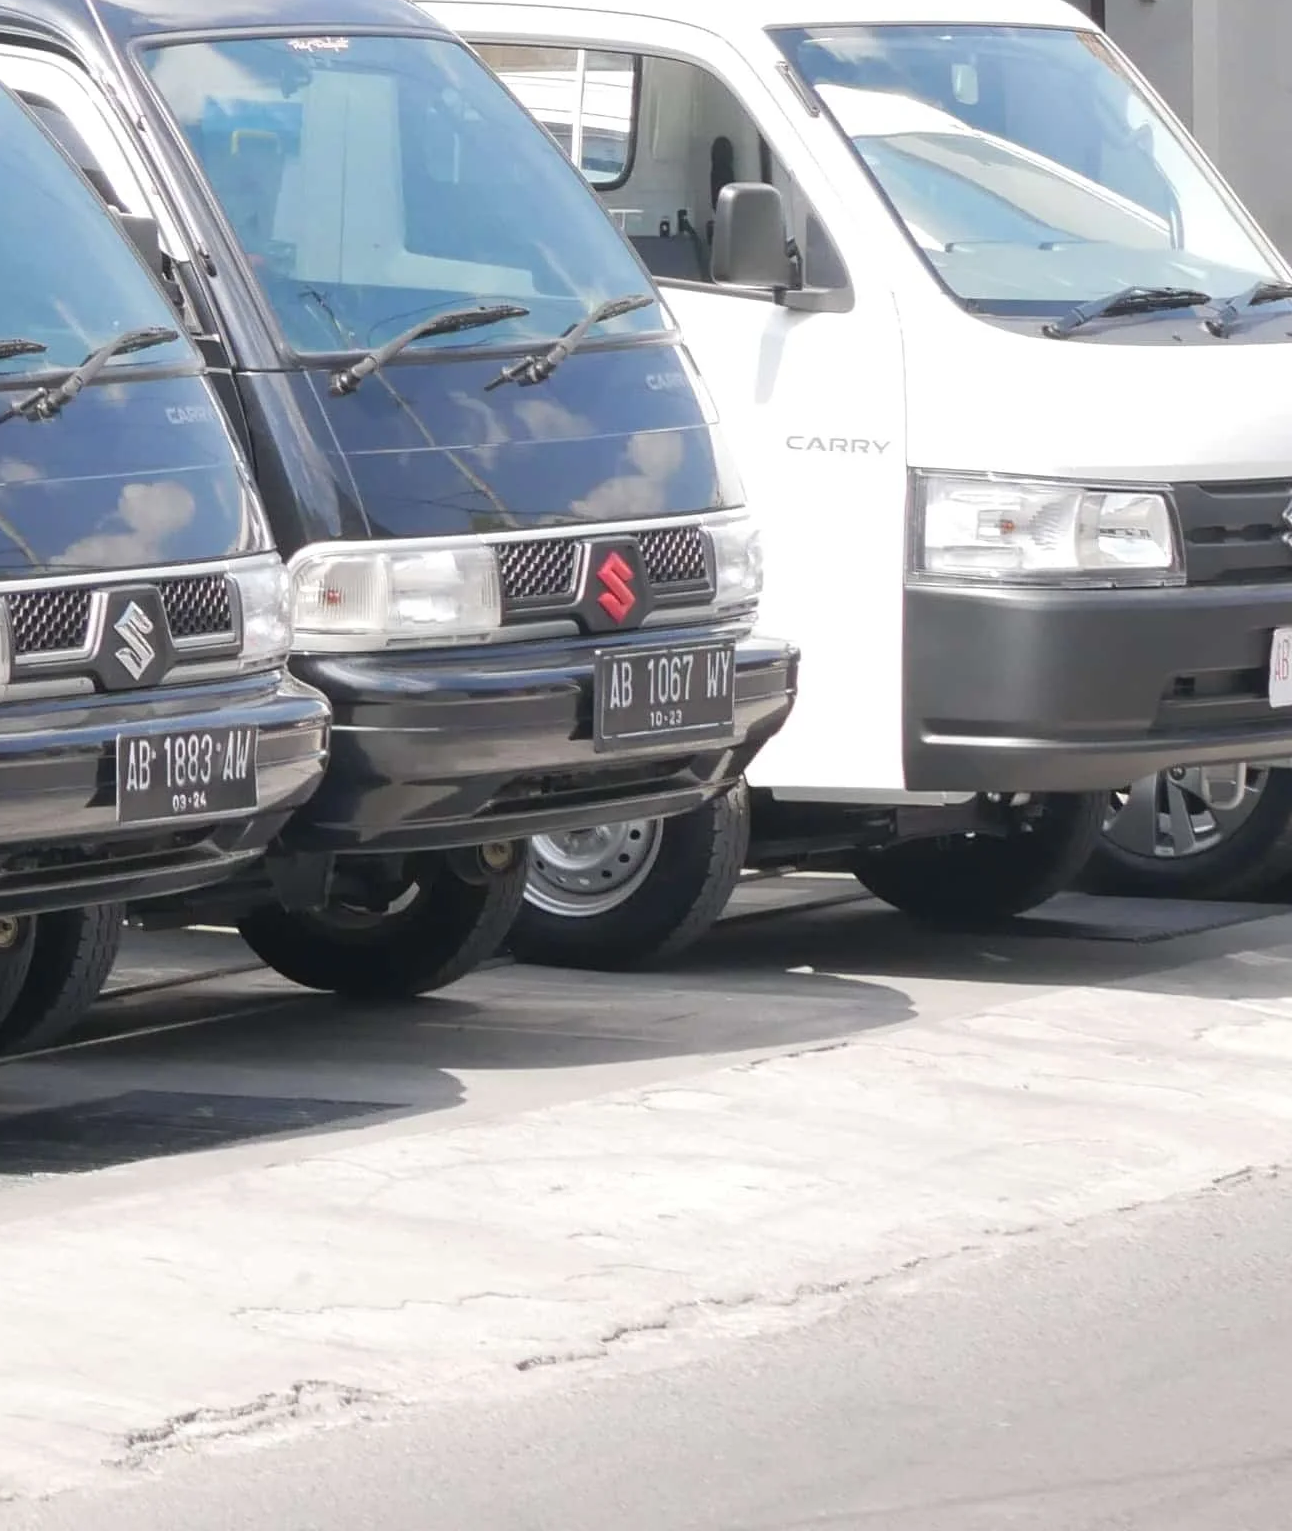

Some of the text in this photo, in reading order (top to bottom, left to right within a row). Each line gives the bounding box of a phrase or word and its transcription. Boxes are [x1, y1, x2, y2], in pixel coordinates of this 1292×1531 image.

[786, 436, 891, 454] CARRY
[610, 650, 731, 709] AB 1067 WY
[126, 730, 251, 790] AB 1883 AW
